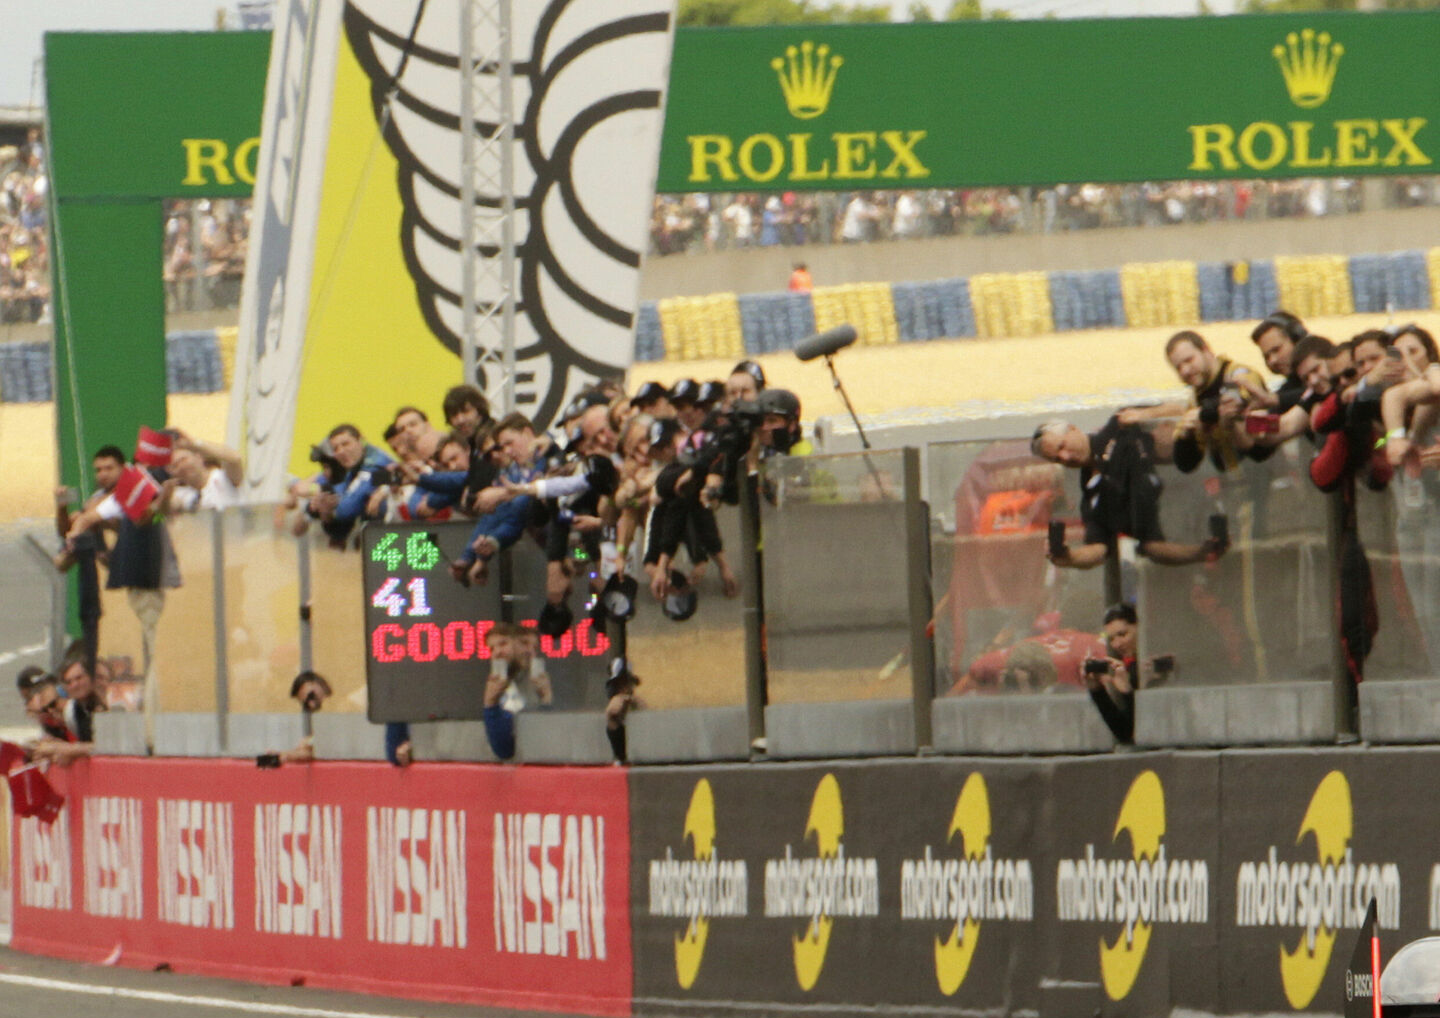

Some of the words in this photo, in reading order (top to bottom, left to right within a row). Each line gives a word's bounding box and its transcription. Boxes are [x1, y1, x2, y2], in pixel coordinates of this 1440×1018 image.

[687, 130, 930, 182] ROLEX
[1187, 117, 1432, 170] ROLEX
[371, 577, 432, 617] 41
[83, 797, 143, 919] NISSAN
[157, 799, 234, 929] NISSAN
[254, 804, 342, 939] NISSAN
[366, 806, 467, 949] NISSAN
[493, 812, 606, 961] NISSAN
[649, 846, 748, 937] motorsport.com
[764, 844, 879, 939] motorsport.com
[901, 845, 1033, 943] motorsport.com
[1057, 844, 1209, 949] motorsport.com
[1237, 846, 1400, 953] motorsport.com
